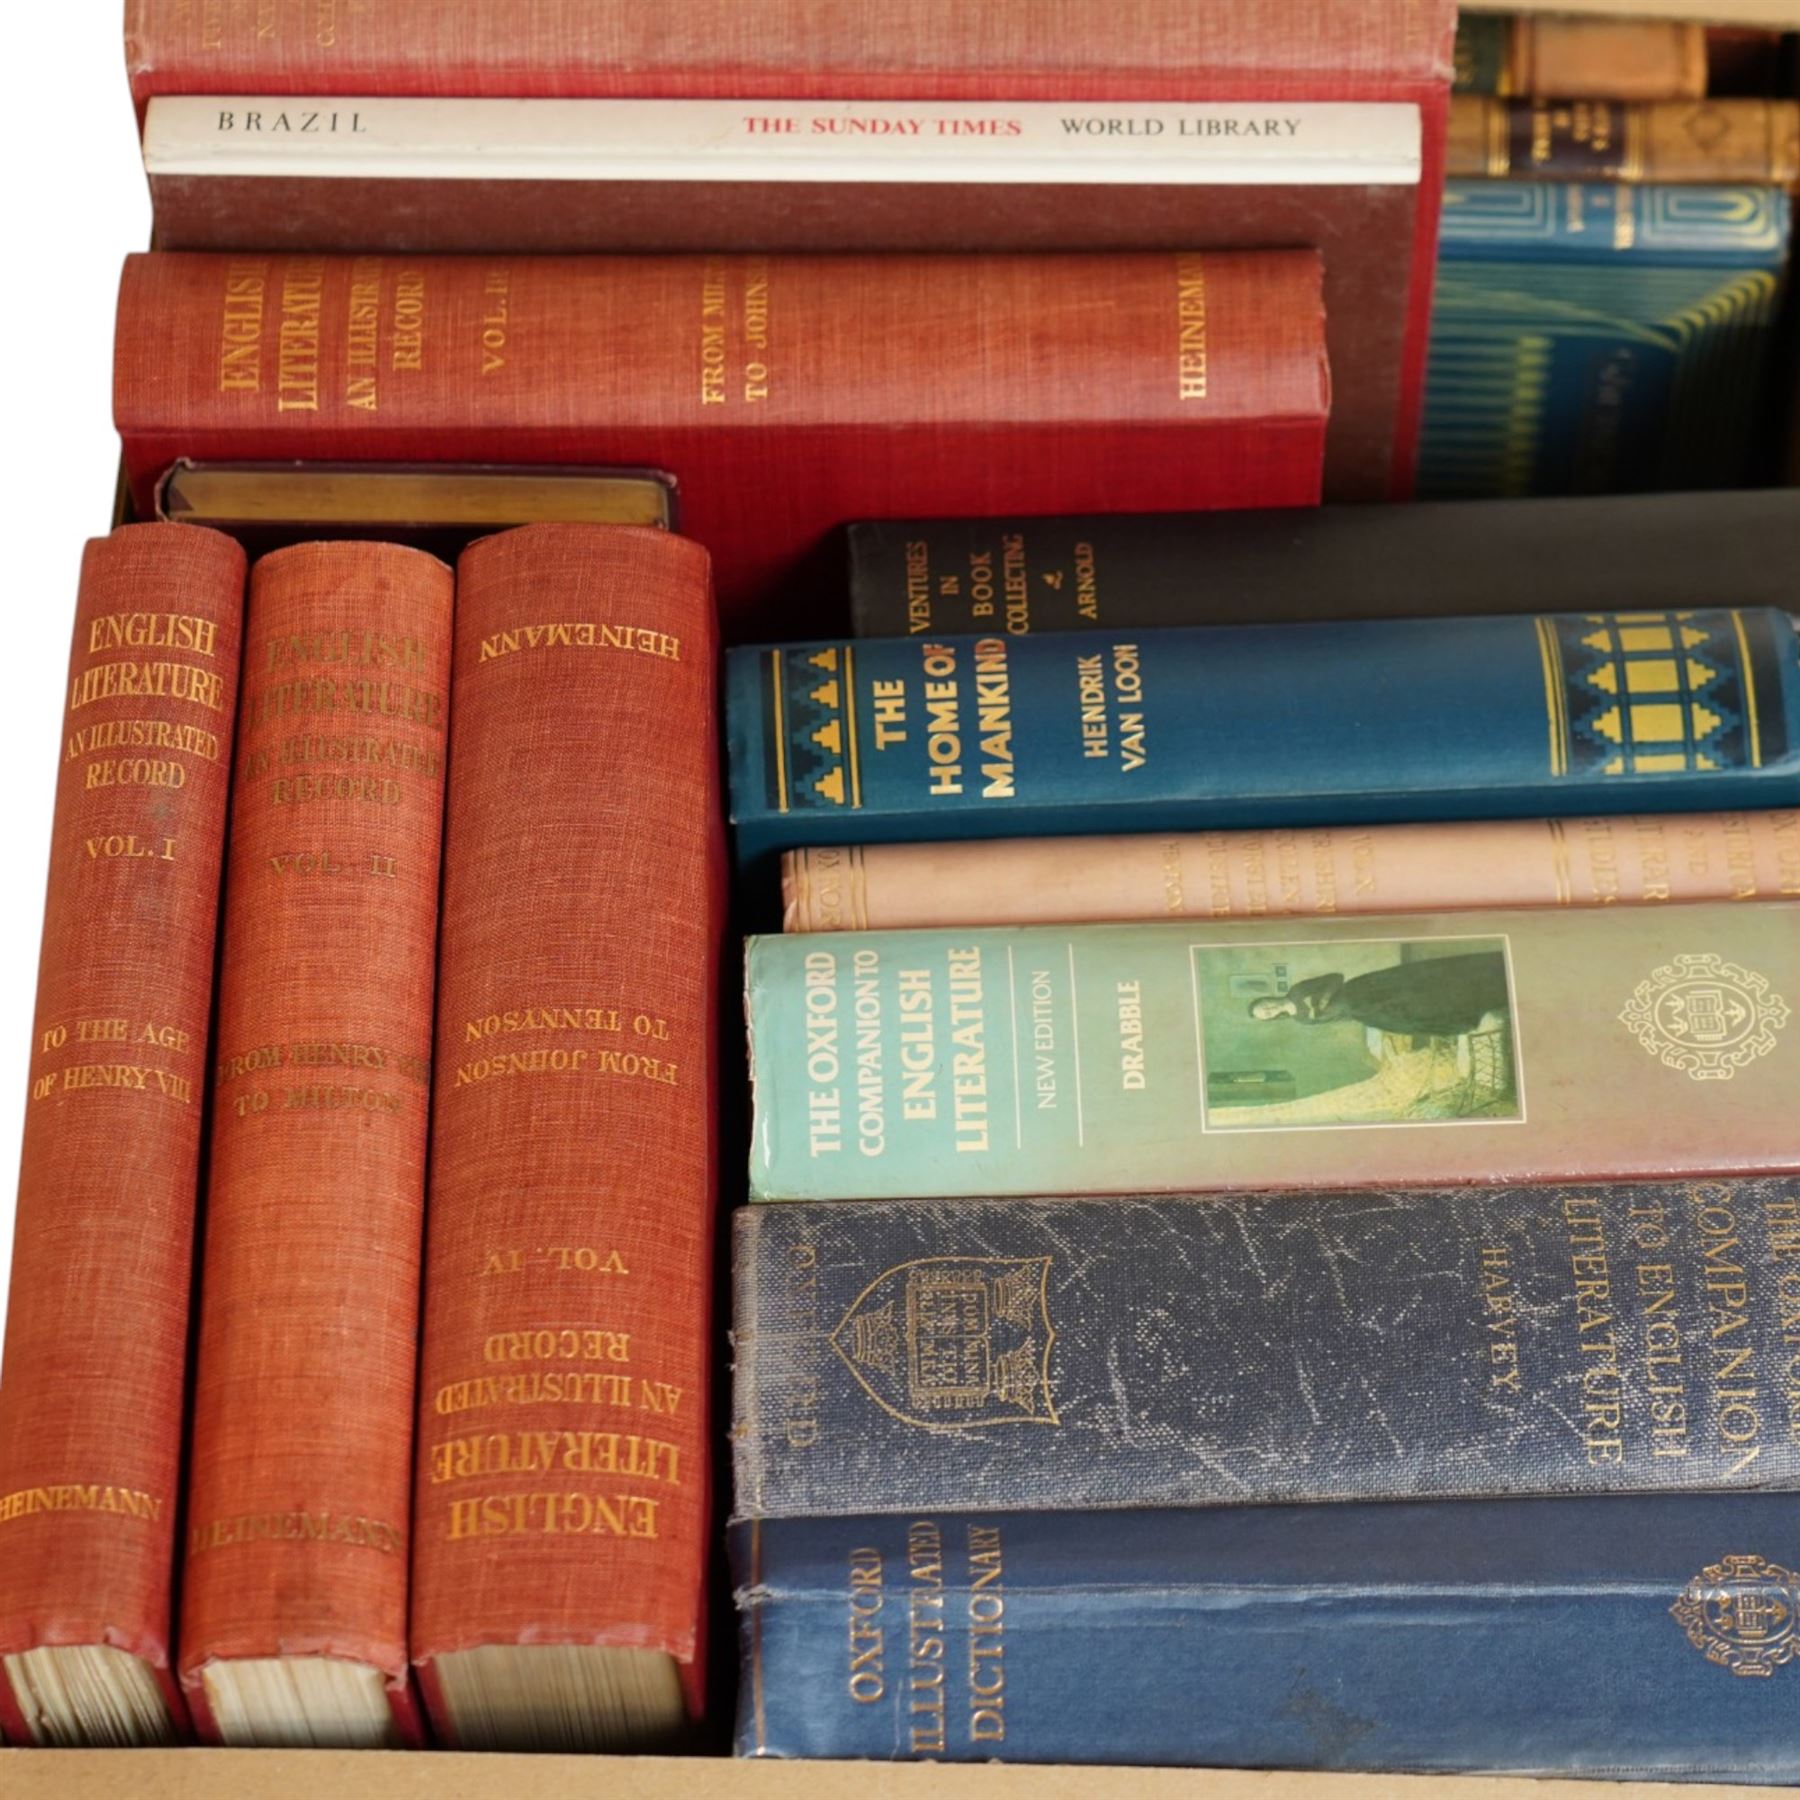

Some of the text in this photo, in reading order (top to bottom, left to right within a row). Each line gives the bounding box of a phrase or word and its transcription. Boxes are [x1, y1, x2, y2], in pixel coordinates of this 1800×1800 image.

[217, 111, 368, 133] BRAZIL
[742, 116, 1023, 137] THE SUNDAY TIMES
[1060, 117, 1303, 138] WORLD LIBRARY
[346, 377, 379, 412] AN
[702, 332, 726, 407] FROM
[745, 362, 769, 403] TO
[906, 540, 931, 634] VENTURES
[940, 575, 960, 596] IN
[970, 551, 994, 617] BOOK
[1002, 533, 1030, 636] COLLECTING
[1075, 541, 1099, 620] ARNOLD
[88, 612, 219, 657] ENGLISH
[478, 622, 681, 664] HEINEMANN
[70, 661, 224, 712] LITERATURE
[1077, 653, 1109, 758] HENDRIK
[1112, 643, 1146, 772] VAN LOON
[90, 718, 220, 762] ILLUSTRATED
[873, 679, 907, 751] THE
[922, 643, 963, 795] HOME OF
[974, 638, 1016, 798] MANKIND
[85, 757, 186, 790] RECORD
[272, 775, 401, 805] RECORD
[41, 1018, 190, 1055] TO THE AGE
[464, 1007, 670, 1042] TO TENNYSON
[898, 969, 937, 1121] ENGLISH
[948, 945, 989, 1153] LITERATURE
[1031, 970, 1058, 1110] NEW EDITION
[1117, 980, 1146, 1091] DRABBLE
[290, 1041, 390, 1071] HENRY
[454, 1048, 588, 1088] JOHNSON
[598, 1050, 679, 1086] FROM
[804, 951, 841, 1158] THE OXFORD
[853, 949, 885, 1157] COMPANION TO
[33, 1063, 191, 1105] OF HENRY VIII
[233, 1089, 270, 1118] TO
[481, 1247, 630, 1277] VOL. IV
[483, 1329, 631, 1364] RECORD
[1482, 1247, 1521, 1393] HARVEY
[1563, 1198, 1624, 1466] LITERATURE
[1628, 1199, 1688, 1457] TO ENGLISH
[1689, 1182, 1761, 1480] COMPANION
[434, 1372, 684, 1416] AN ILLUSTRATED
[430, 1431, 682, 1486] LITERATURE
[0, 1483, 162, 1523] HEINEMANN
[447, 1492, 661, 1541] ENGLISH
[848, 1547, 884, 1704] OXFORD
[907, 1520, 946, 1753] ILLUSTRATED
[967, 1522, 1006, 1742] DICTIONARY
